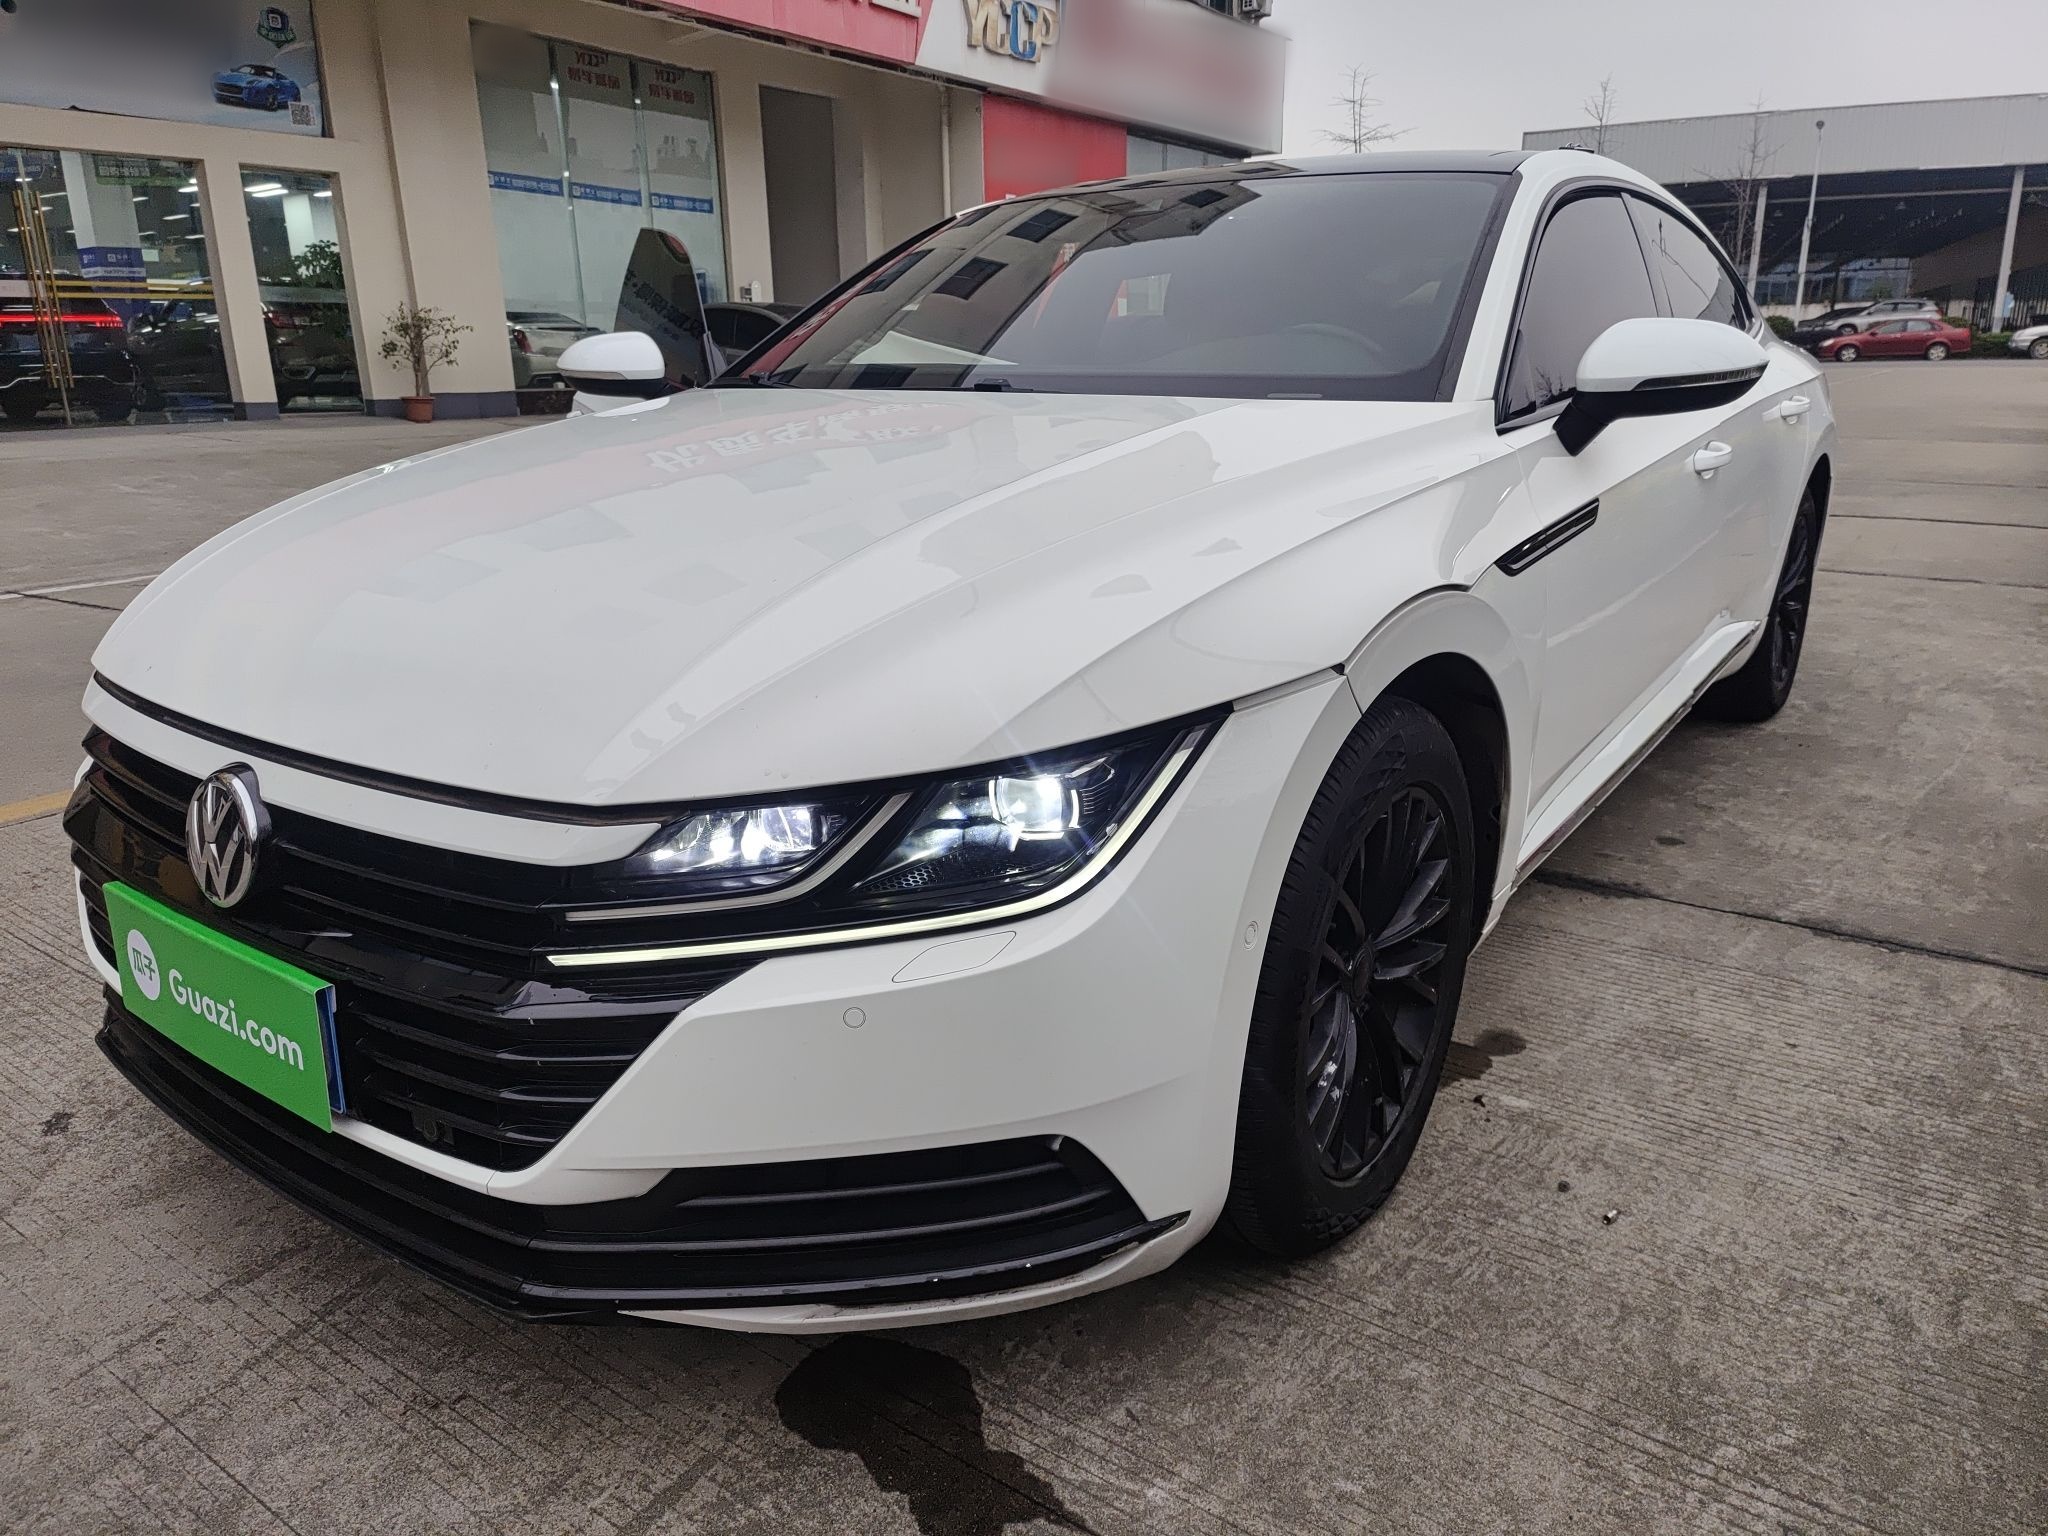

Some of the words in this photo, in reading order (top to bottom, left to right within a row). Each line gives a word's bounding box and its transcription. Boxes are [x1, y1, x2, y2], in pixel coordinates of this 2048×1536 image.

[963, 0, 1060, 63] YCCP
[132, 947, 156, 982] 瓜子
[168, 968, 304, 1071] Guazi.com
